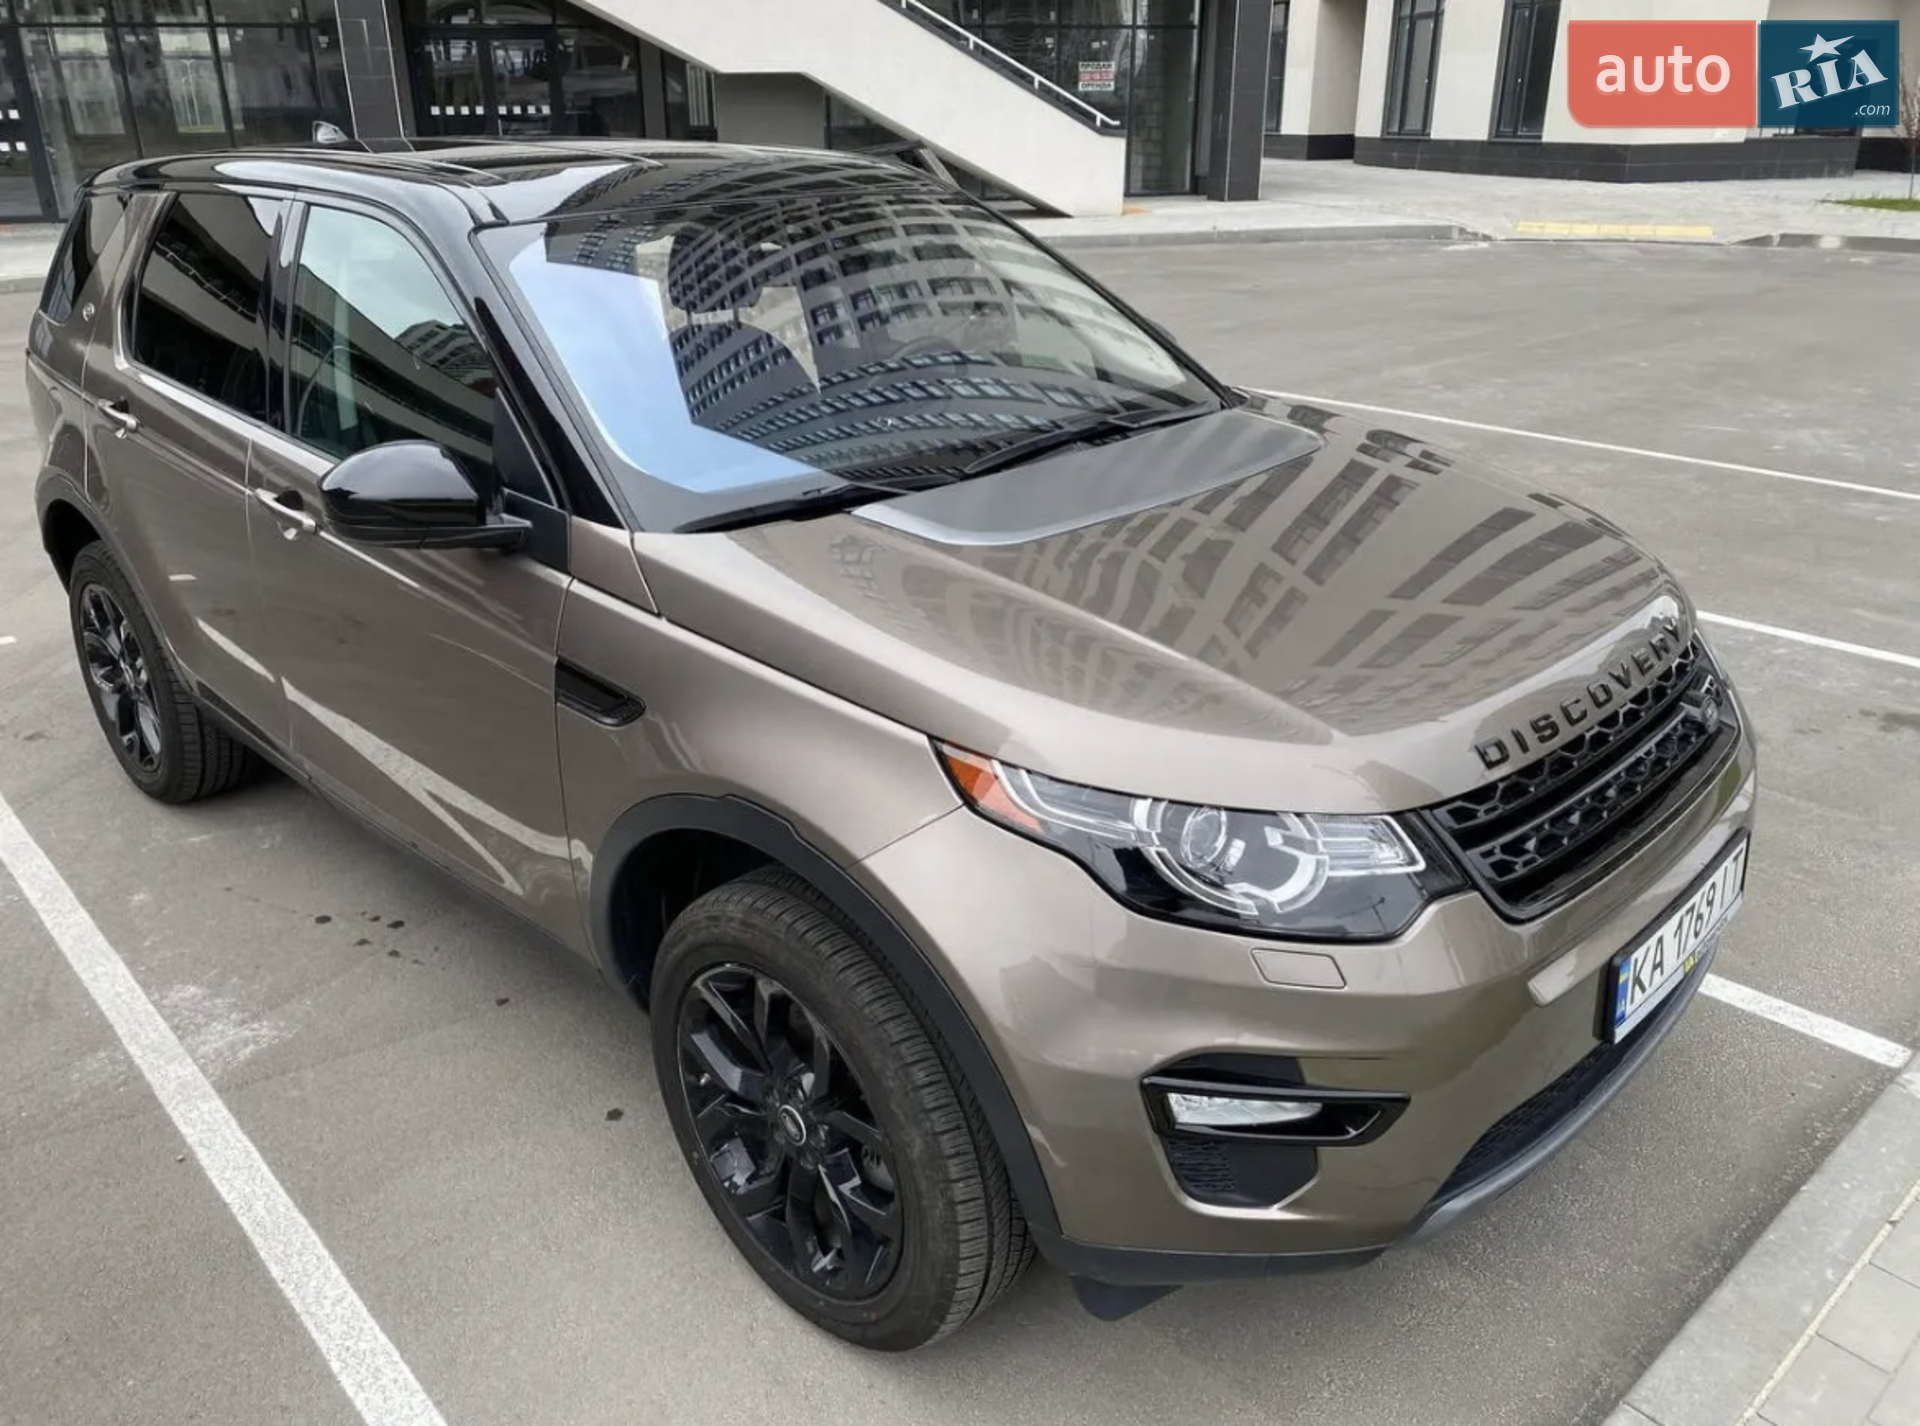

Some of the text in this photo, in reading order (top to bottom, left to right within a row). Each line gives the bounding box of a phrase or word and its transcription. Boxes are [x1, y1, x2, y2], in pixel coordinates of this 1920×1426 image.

[1474, 617, 1681, 770] DISCOVERY
[1630, 935, 1665, 1005] KA
[1673, 880, 1716, 960] 1769
[1720, 847, 1744, 909] IT
